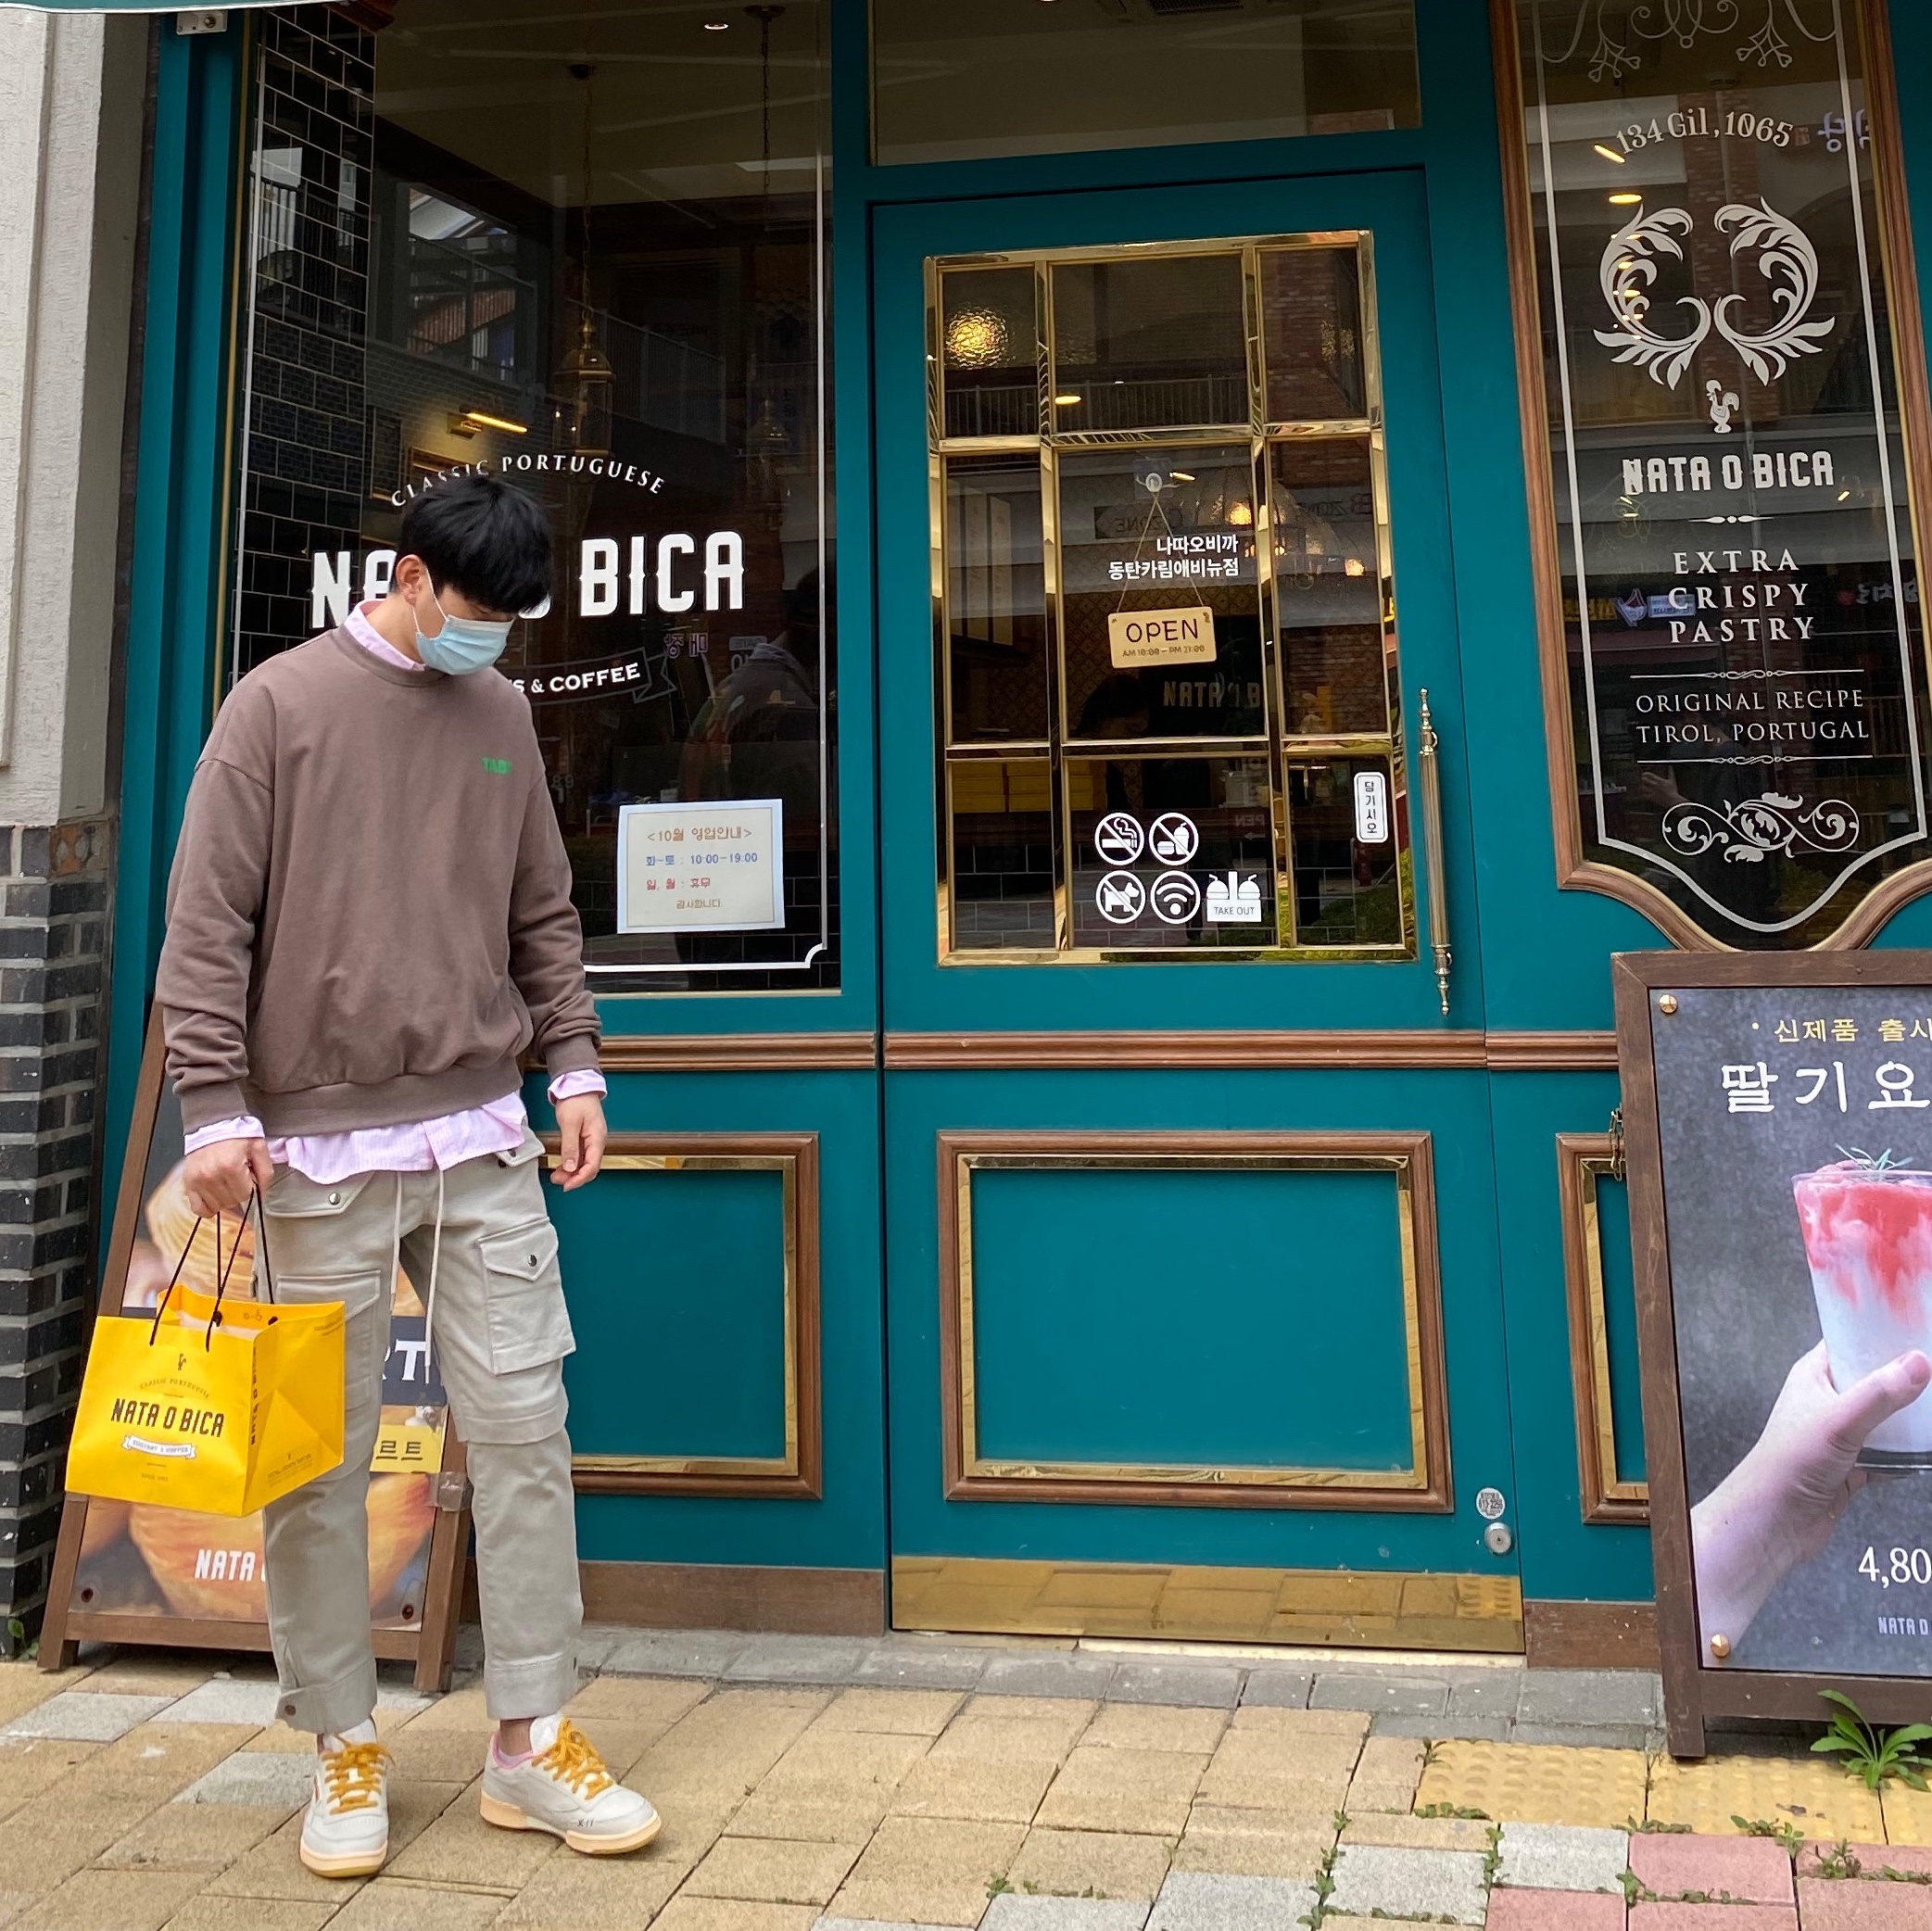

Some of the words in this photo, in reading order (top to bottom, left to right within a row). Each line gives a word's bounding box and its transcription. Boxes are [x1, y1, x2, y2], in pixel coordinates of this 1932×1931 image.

[1616, 118, 1664, 155] 134
[1724, 111, 1794, 147] 1065
[502, 454, 665, 494] PORTUGUESE
[1623, 455, 1711, 495] NATA
[1722, 454, 1743, 490] O
[1752, 450, 1835, 489] BICA
[1156, 534, 1239, 556] 나따오비까
[1107, 557, 1239, 581] 동탄카림애비뉴점
[1673, 549, 1799, 575] EXTRA
[311, 549, 397, 629] NA
[579, 531, 746, 618] BICA
[1668, 583, 1809, 610] CRISPY
[1126, 618, 1198, 643] OPEN
[1669, 617, 1814, 644] PASTRY
[531, 679, 545, 694] &
[549, 663, 641, 692] COFFEE
[1164, 681, 1224, 708] NATA
[1636, 692, 1765, 713] ORIGINAL
[1776, 689, 1864, 709] RECIPE
[1636, 724, 1721, 744] TIROL,
[1733, 720, 1870, 741] PORTUGAL
[690, 877, 711, 889] 휴무
[1213, 906, 1234, 915] TAKE
[1236, 906, 1256, 915] OUT
[1774, 1018, 1859, 1042] 신제품
[110, 1397, 160, 1428] NATA
[162, 1406, 177, 1430] O
[179, 1407, 225, 1438] BICA
[194, 1548, 257, 1583] NATA
[1877, 1616, 1916, 1635] NATA
